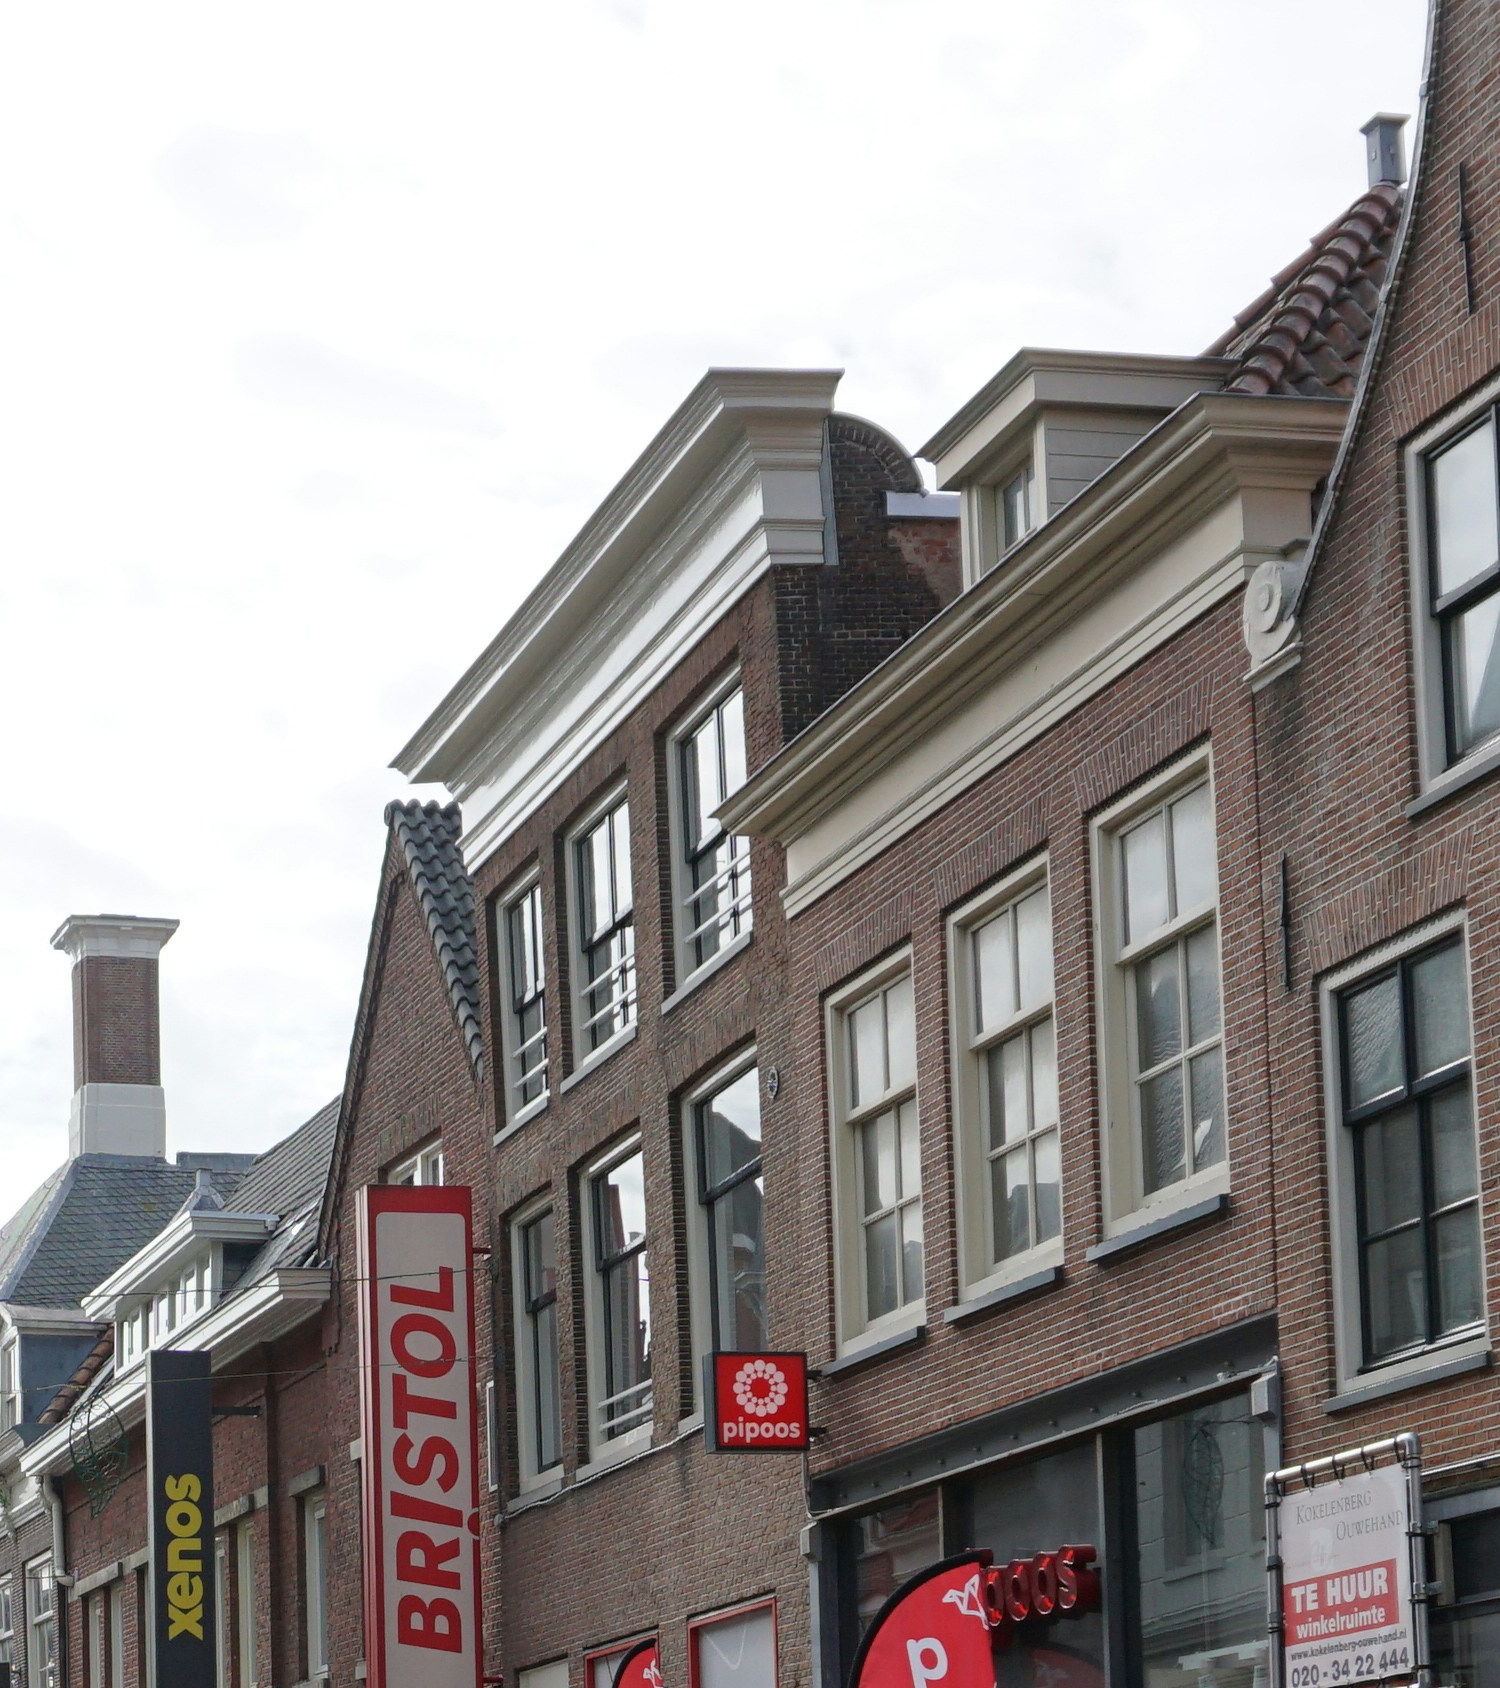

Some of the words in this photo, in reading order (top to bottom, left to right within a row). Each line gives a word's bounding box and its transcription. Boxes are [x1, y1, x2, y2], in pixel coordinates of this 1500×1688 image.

[723, 1416, 800, 1443] pipoos
[390, 1266, 480, 1653] BRISTOL
[1296, 1490, 1372, 1525] KOKELENBERG
[1336, 1510, 1403, 1540] OUWEHAND
[165, 1473, 204, 1640] xenos
[1291, 1583, 1319, 1613] TE
[1326, 1567, 1389, 1606] HUUR
[1296, 1605, 1385, 1639] winkelruimte
[1292, 1664, 1319, 1688] 020
[1332, 1659, 1350, 1681] 34
[1355, 1653, 1375, 1677] 22
[1379, 1647, 1409, 1673] 444
